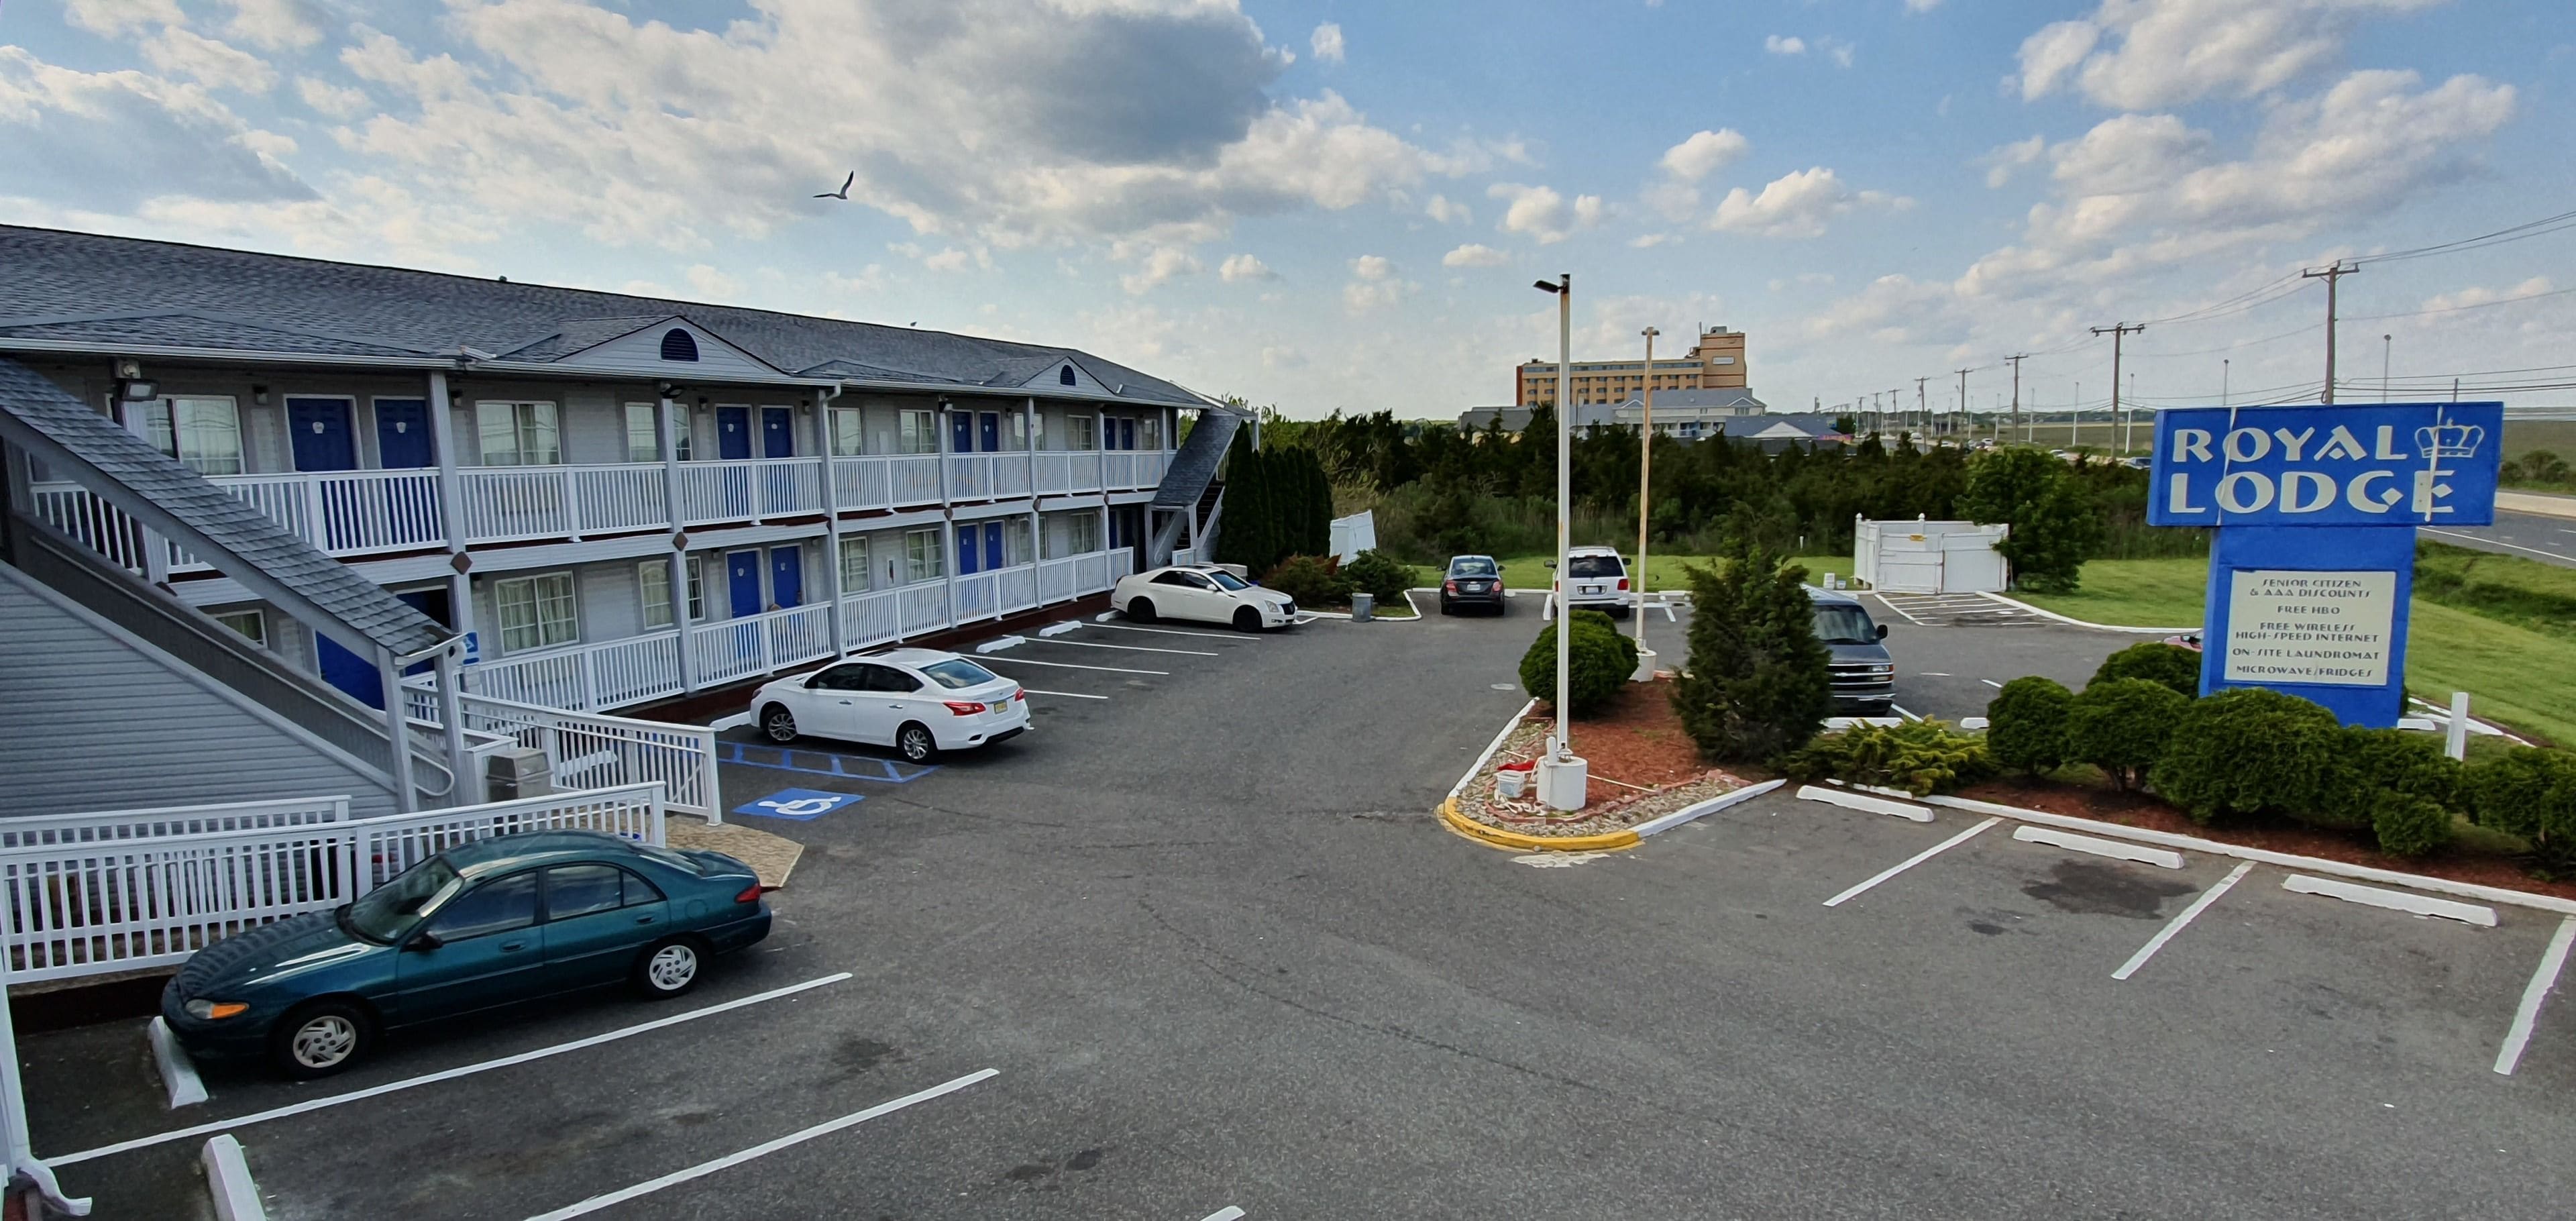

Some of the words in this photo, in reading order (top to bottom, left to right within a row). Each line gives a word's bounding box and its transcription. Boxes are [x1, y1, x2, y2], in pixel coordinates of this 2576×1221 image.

[2173, 425, 2408, 464] ROYAL
[2169, 470, 2455, 515] LODGE
[2262, 578, 2308, 588] SENIOR
[2312, 579, 2361, 588] CITIZEN
[2249, 588, 2259, 596] &
[2263, 588, 2294, 596] AAA
[2298, 588, 2371, 598] DISCOUNTS
[2277, 605, 2308, 614] FREE
[2311, 605, 2341, 615] HBO
[2259, 622, 2290, 631] FREE
[2294, 623, 2356, 632] WIRELESS
[2235, 631, 2312, 641] HIGH-SPEED
[2316, 633, 2379, 643] INTERNET
[2232, 648, 2282, 657] ON-SITE
[2286, 649, 2380, 660] LAUNDROMAT
[2236, 665, 2373, 678] MICROWAVE/FRIDGES
